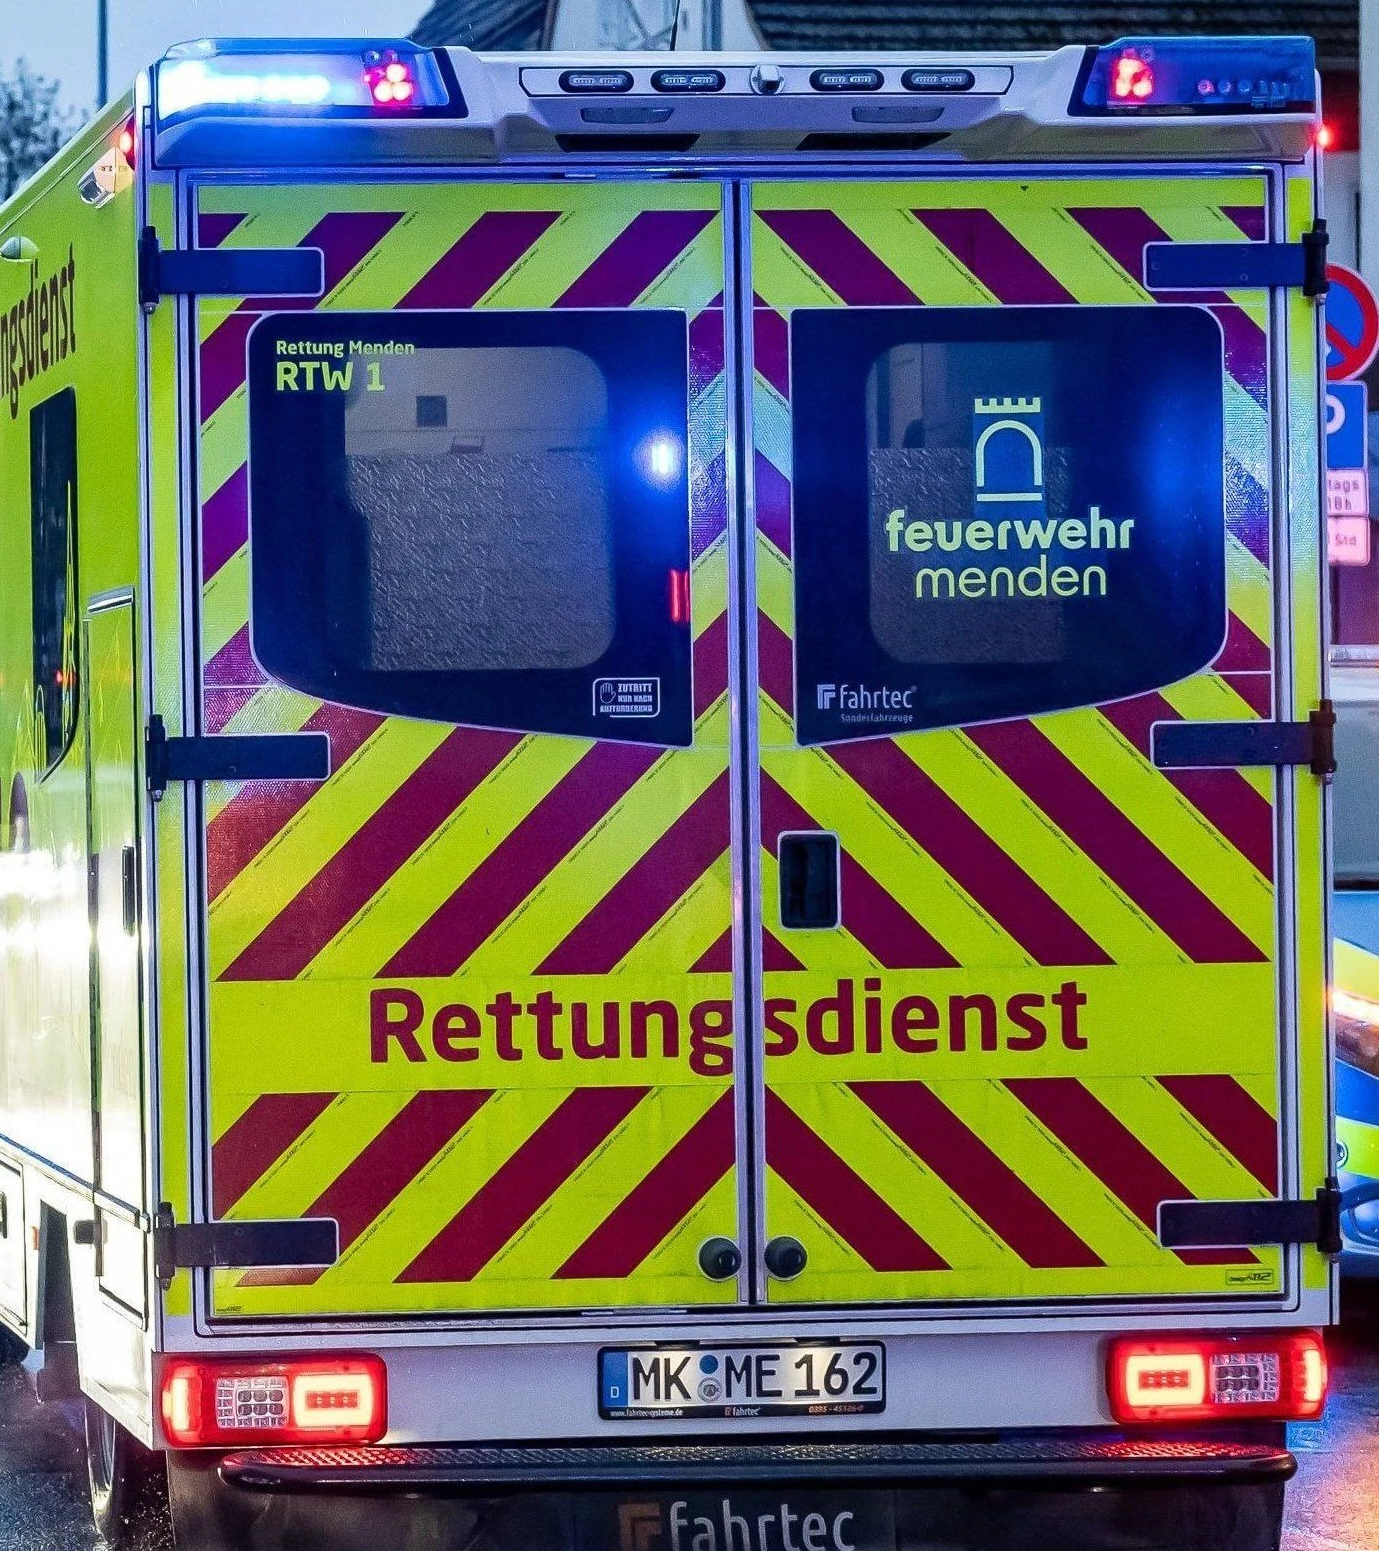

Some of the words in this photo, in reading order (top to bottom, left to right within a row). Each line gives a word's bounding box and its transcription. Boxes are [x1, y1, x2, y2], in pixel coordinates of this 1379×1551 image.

[276, 340, 344, 358] Rettung
[349, 340, 415, 355] Menden
[276, 361, 353, 391] RTW
[367, 362, 385, 391] 1
[886, 507, 1134, 551] feuerwehr
[916, 554, 1106, 598] menden
[618, 683, 652, 693] ZUTRITT
[840, 684, 913, 709] fahrtec
[841, 713, 913, 723] Sonderfahrzeuge
[371, 977, 1088, 1077] Rettungsdienst
[610, 1386, 619, 1398] D
[632, 1356, 692, 1401] MK
[725, 1354, 782, 1398] ME
[794, 1352, 877, 1397] 162
[733, 1406, 760, 1416] fahrtec
[671, 1499, 855, 1551] fahrtec
